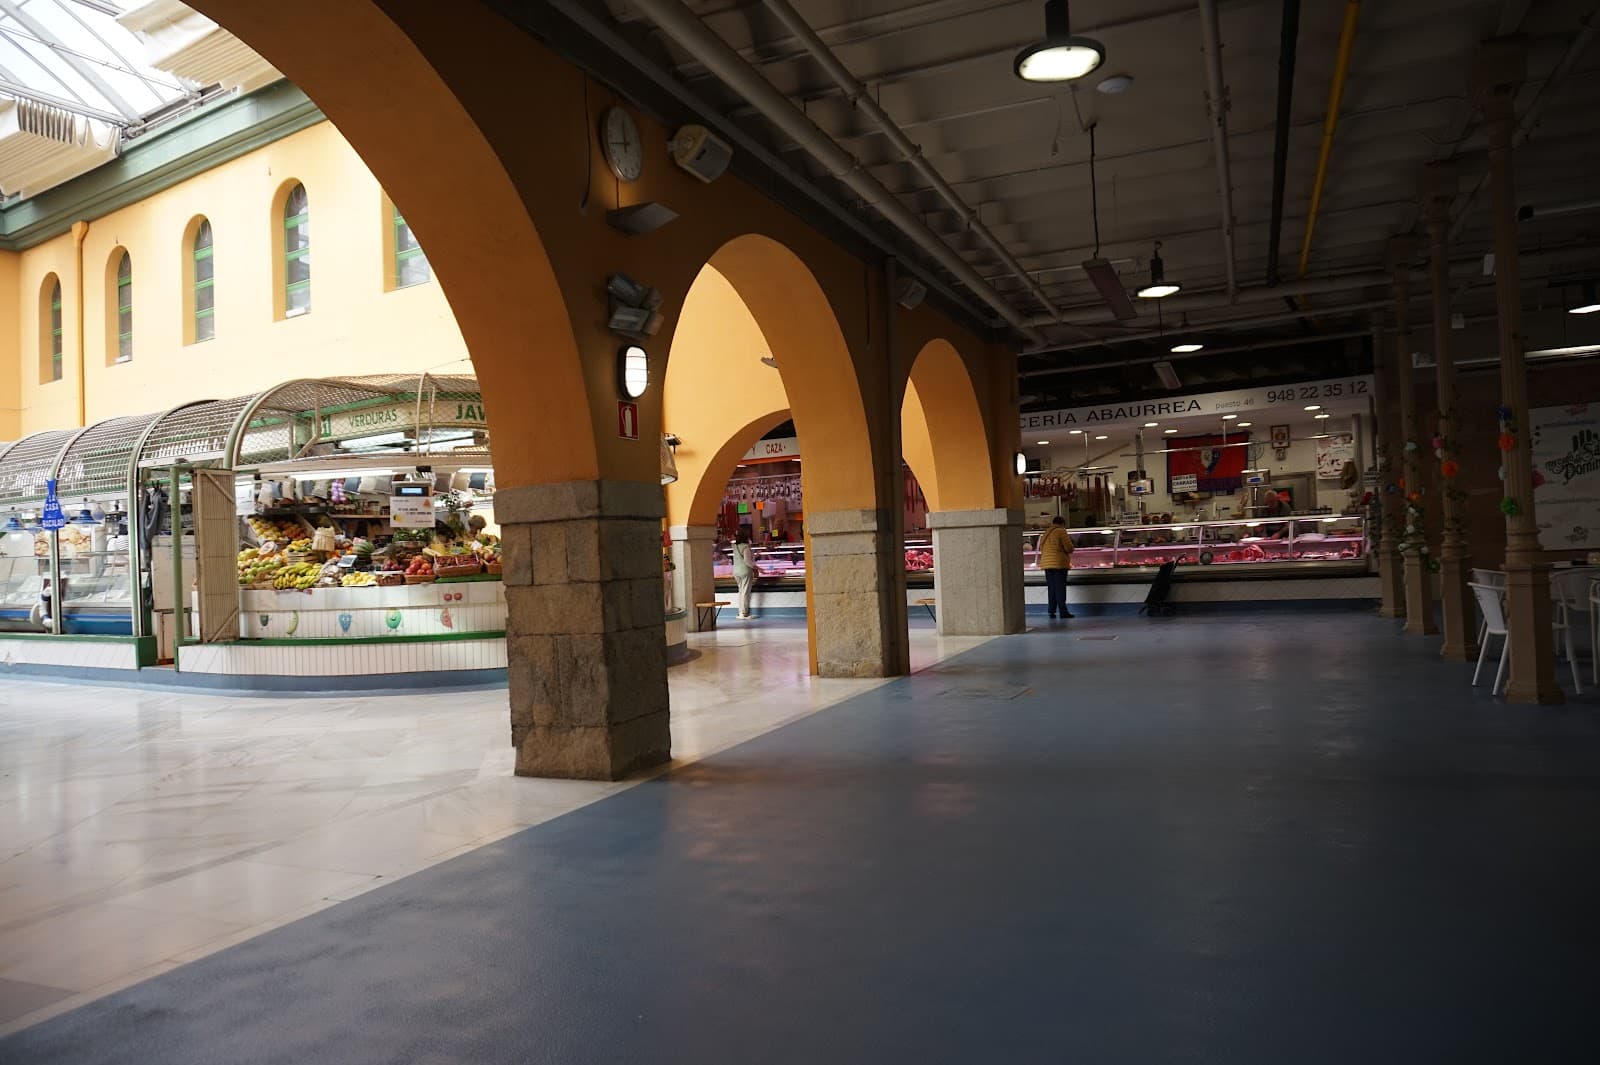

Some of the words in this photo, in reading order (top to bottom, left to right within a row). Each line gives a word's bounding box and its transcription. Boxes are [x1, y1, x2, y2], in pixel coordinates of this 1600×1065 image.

[1267, 388, 1295, 403] 948
[1299, 386, 1319, 400] 22
[1323, 383, 1343, 397] 35
[1350, 380, 1368, 394] 12
[1086, 399, 1201, 422] ABAURREA
[1215, 399, 1240, 411] puesto
[348, 408, 398, 428] VERDURAS
[765, 442, 783, 454] CAZA
